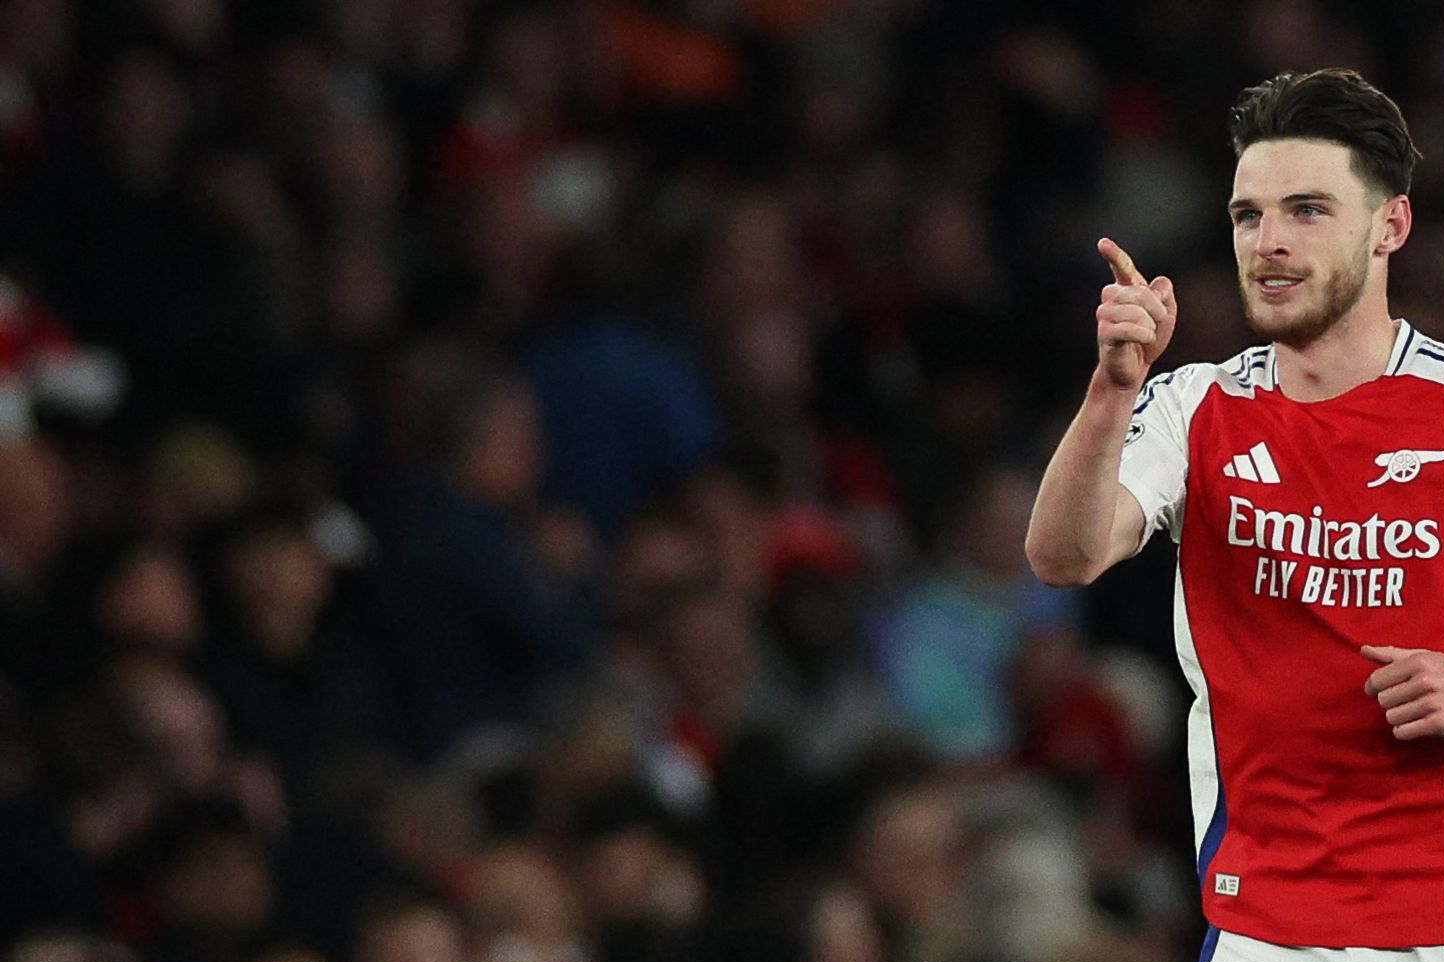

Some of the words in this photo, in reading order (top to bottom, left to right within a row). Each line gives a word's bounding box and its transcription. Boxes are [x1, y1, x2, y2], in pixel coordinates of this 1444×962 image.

[1227, 495, 1441, 561] Emirates
[1254, 556, 1298, 600] FLY
[1301, 565, 1405, 608] BETTER
